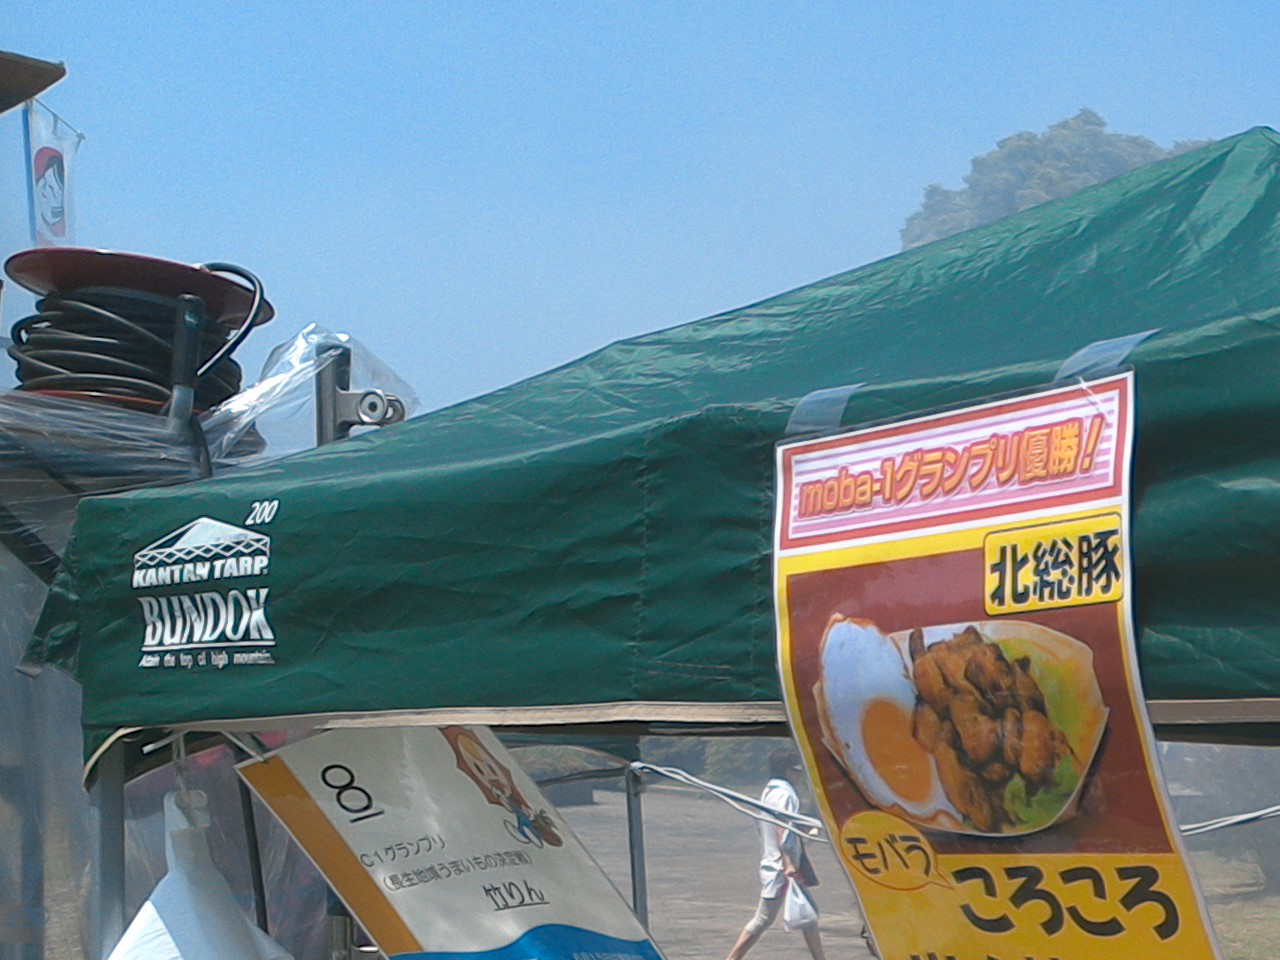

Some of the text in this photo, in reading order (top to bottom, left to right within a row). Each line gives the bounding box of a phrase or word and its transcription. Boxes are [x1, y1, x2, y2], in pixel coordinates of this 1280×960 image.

[245, 500, 279, 525] 200
[132, 561, 211, 588] KANTAN
[990, 528, 1122, 607] 北総豚
[138, 588, 274, 646] BUNDOK
[846, 833, 933, 876] モバラ
[953, 865, 1179, 941] ころころ
